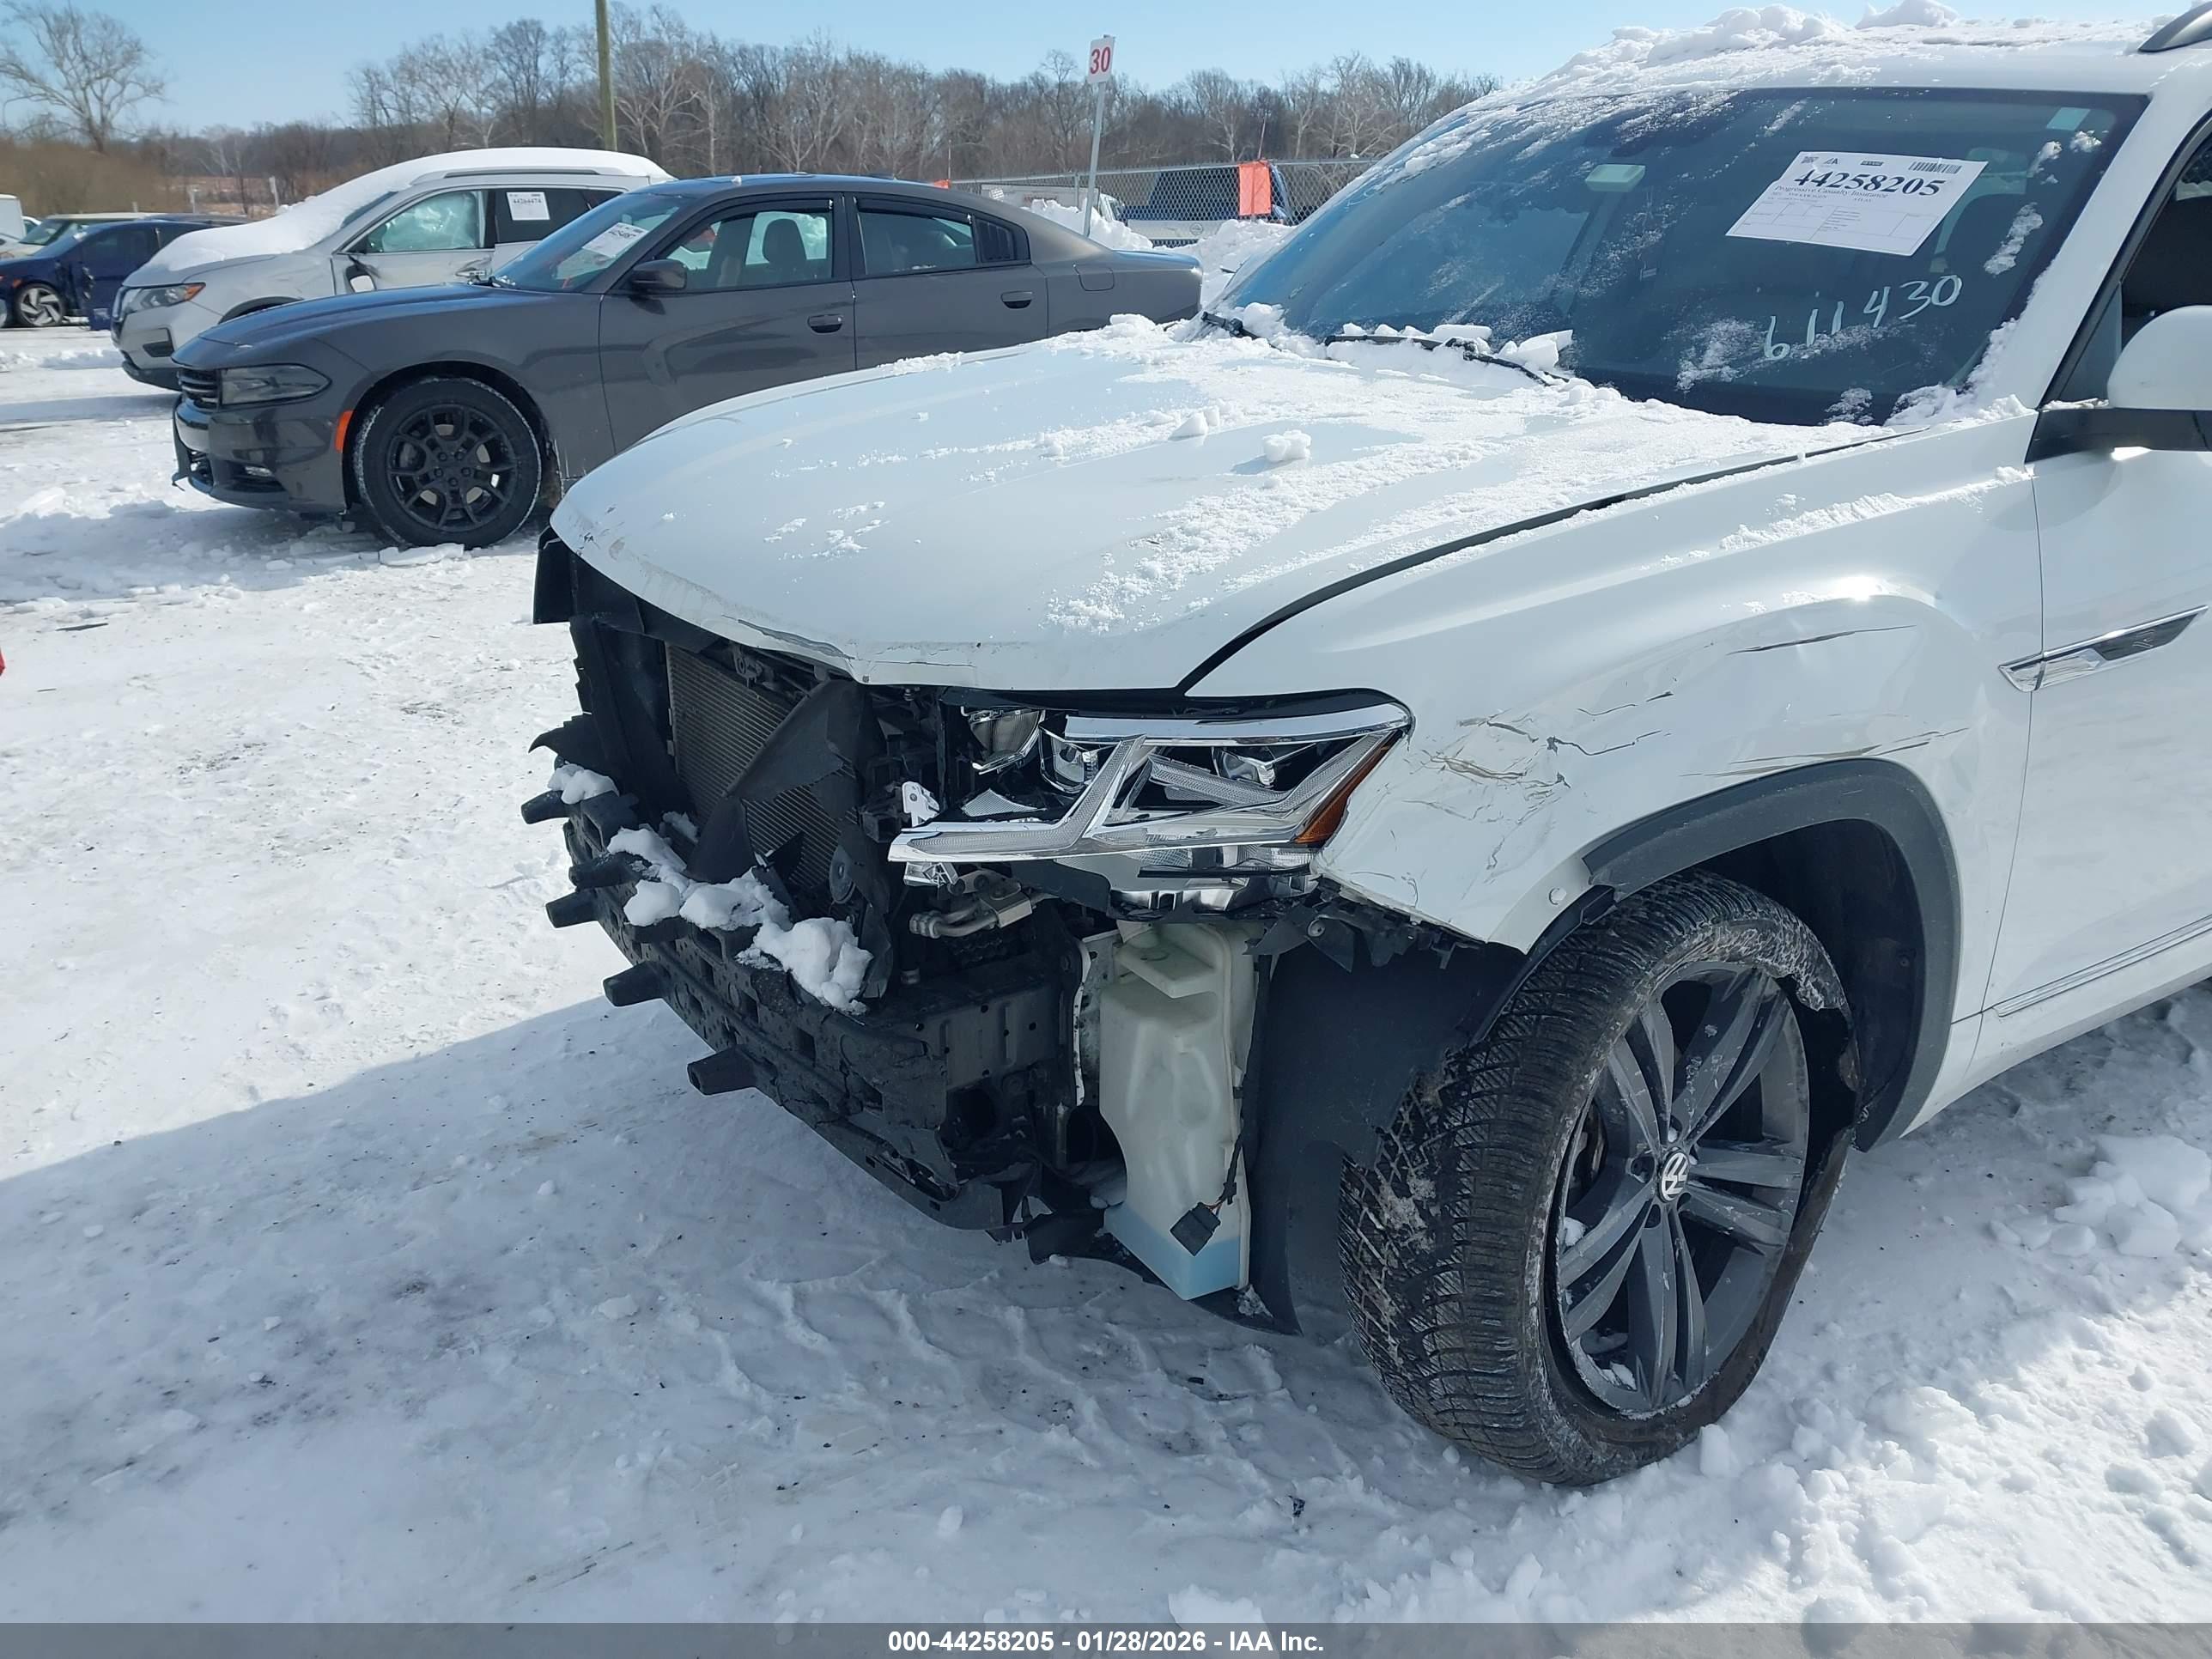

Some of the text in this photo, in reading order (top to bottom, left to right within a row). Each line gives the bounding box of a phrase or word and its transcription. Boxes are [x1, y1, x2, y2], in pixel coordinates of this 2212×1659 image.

[1091, 46, 1111, 75] 30
[1774, 185, 1818, 194] Progressive
[1818, 187, 1849, 196] Casualty
[1850, 191, 1889, 199] Insurance
[1794, 169, 1946, 196] 44258205
